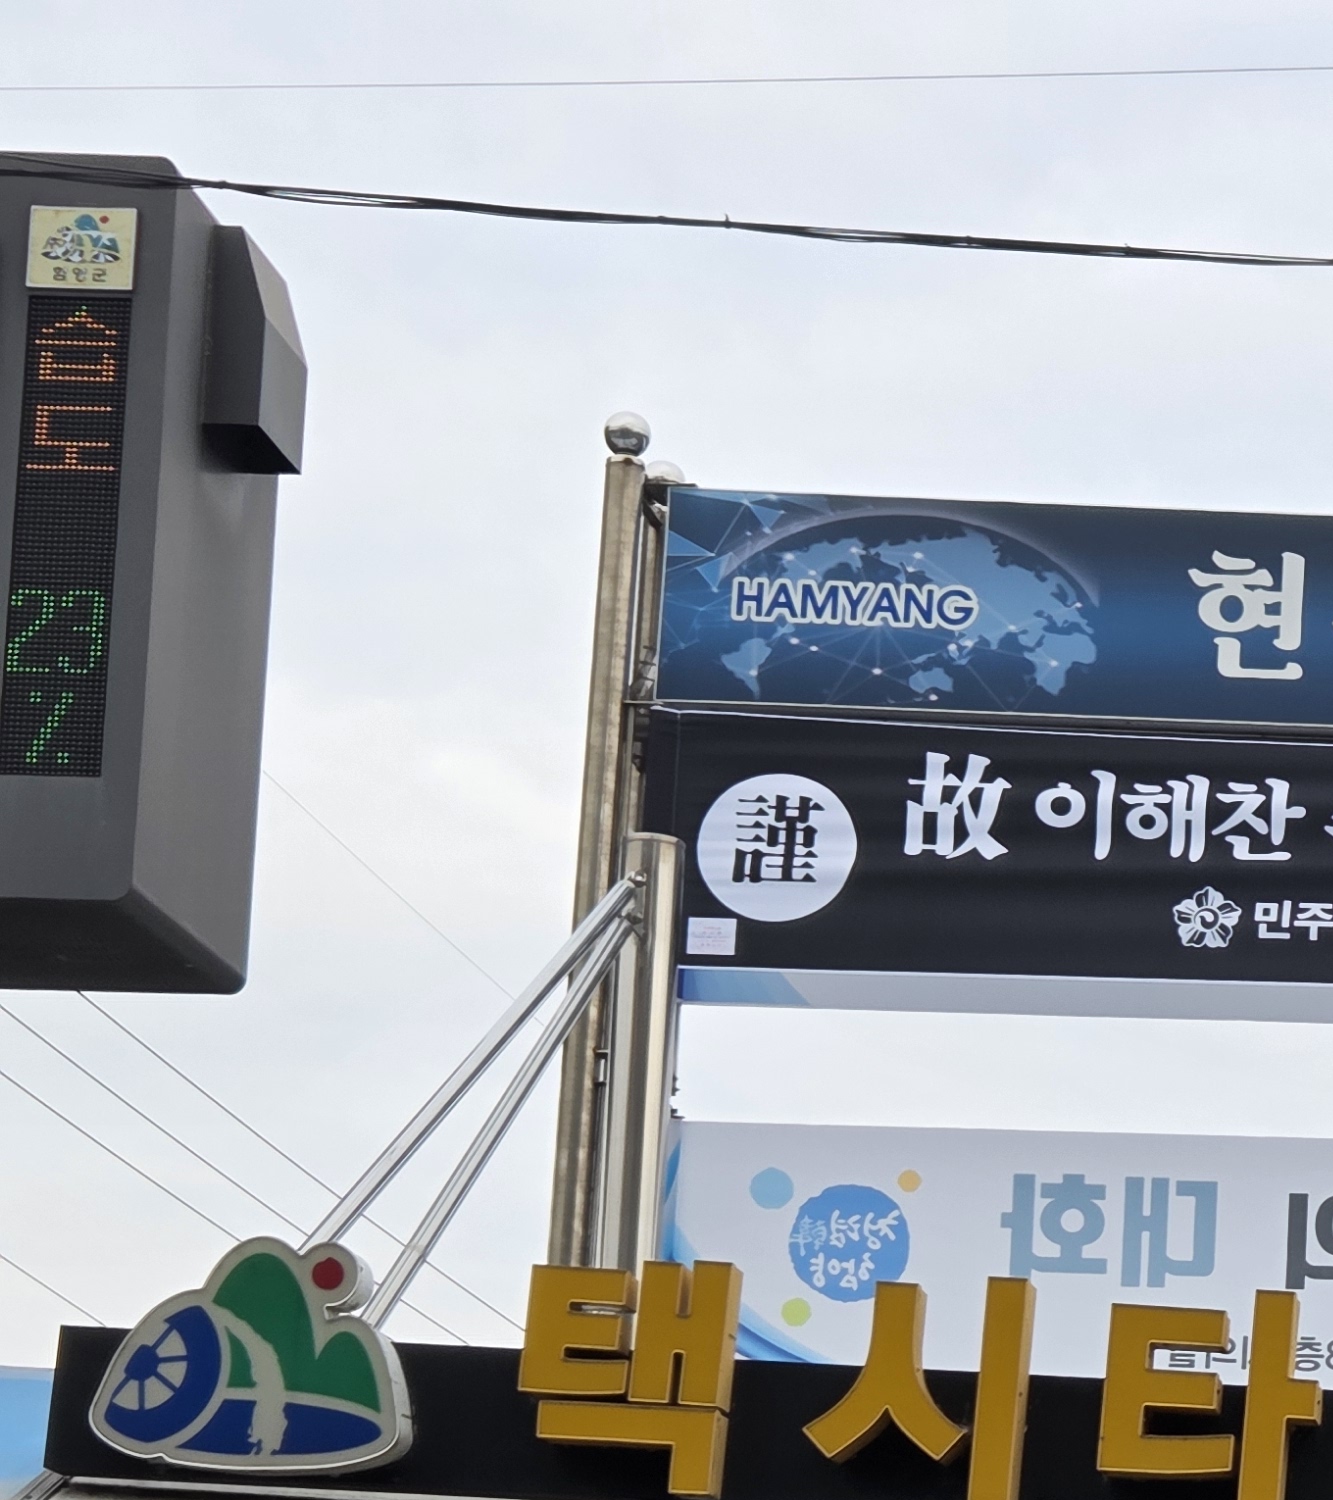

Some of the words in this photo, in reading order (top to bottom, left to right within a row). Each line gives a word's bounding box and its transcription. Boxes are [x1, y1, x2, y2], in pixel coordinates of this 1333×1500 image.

[26, 304, 118, 473] 습도
[5, 588, 107, 677] 23
[731, 577, 980, 631] HAMYANG
[731, 793, 826, 887] 謹
[903, 751, 1013, 862] 故
[1033, 768, 1308, 863] 이해찬
